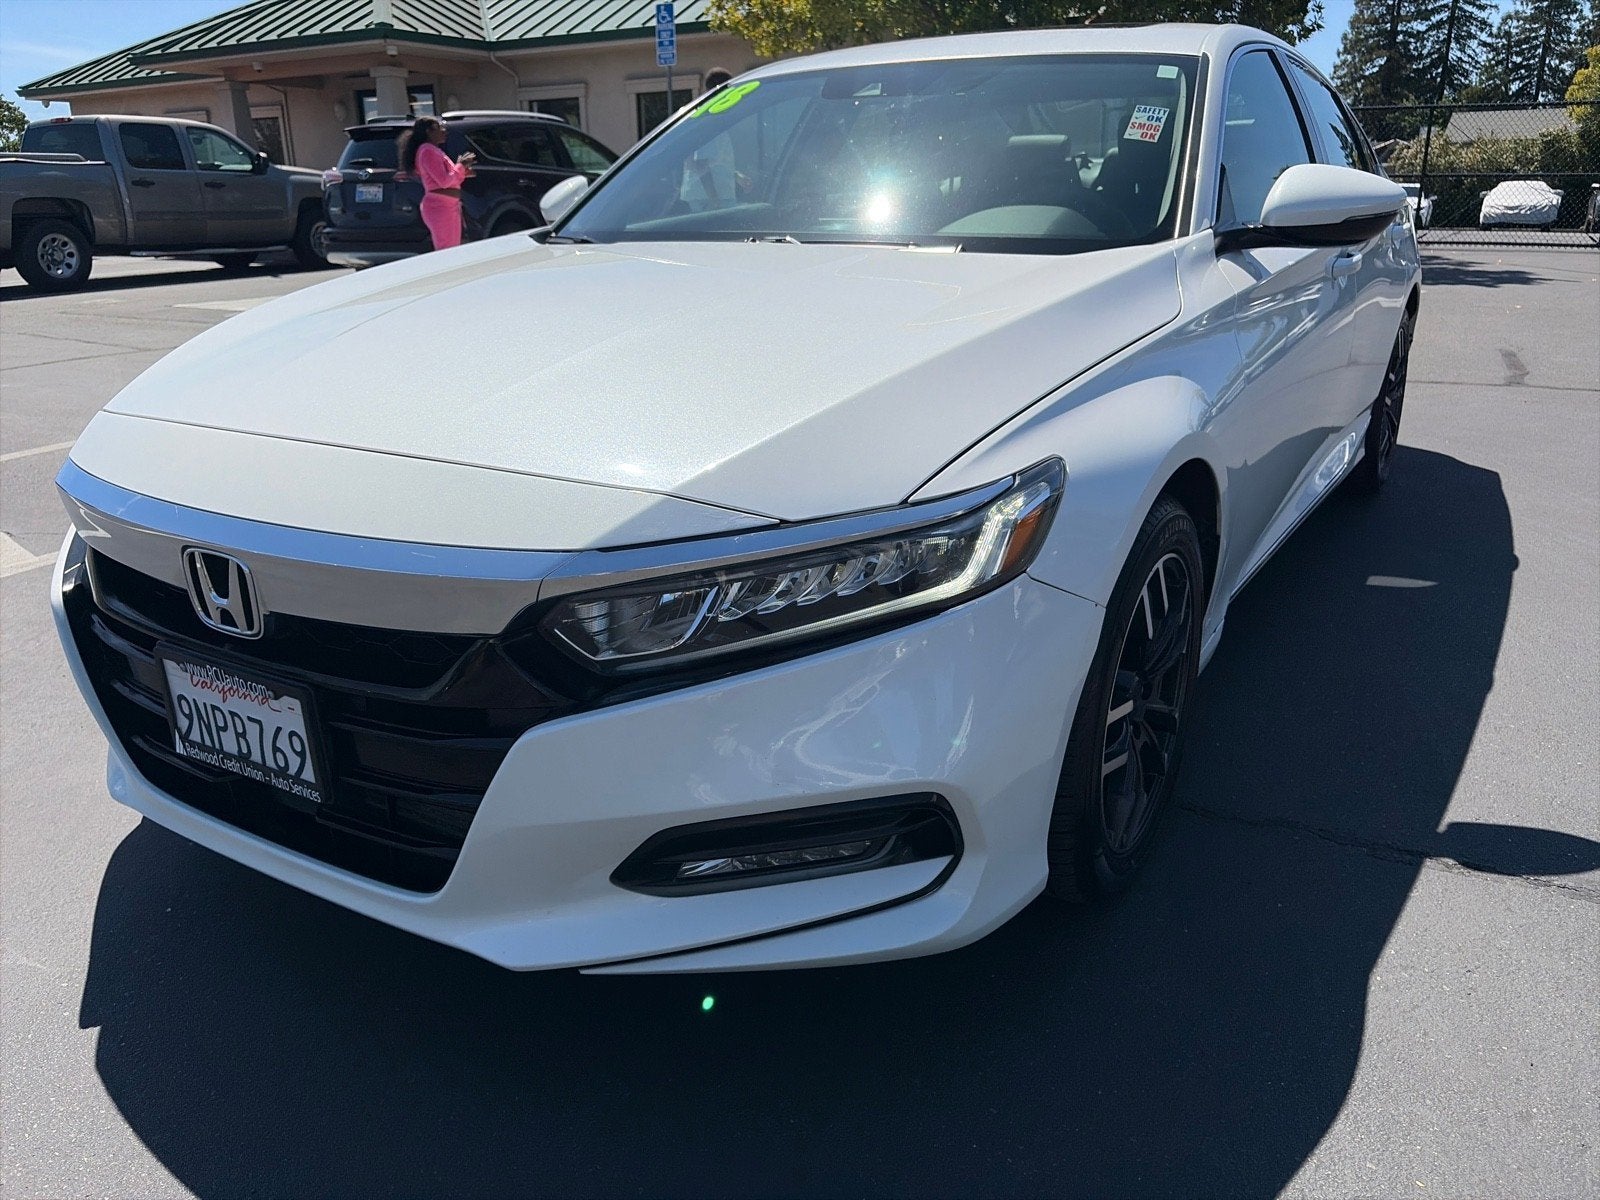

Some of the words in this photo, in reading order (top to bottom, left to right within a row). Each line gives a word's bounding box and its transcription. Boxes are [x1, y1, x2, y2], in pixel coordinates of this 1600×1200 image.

[1136, 106, 1168, 115] SAFETY
[1147, 115, 1163, 123] OK
[1130, 121, 1161, 132] SMOG
[1140, 131, 1157, 140] OK
[184, 661, 269, 697] www.RCUauto.com
[176, 693, 307, 779] 9NPB769
[185, 743, 220, 766] Redwood
[220, 755, 241, 772] Credit
[241, 762, 265, 781] Union
[271, 773, 290, 790] Auto
[290, 780, 322, 803] Services
